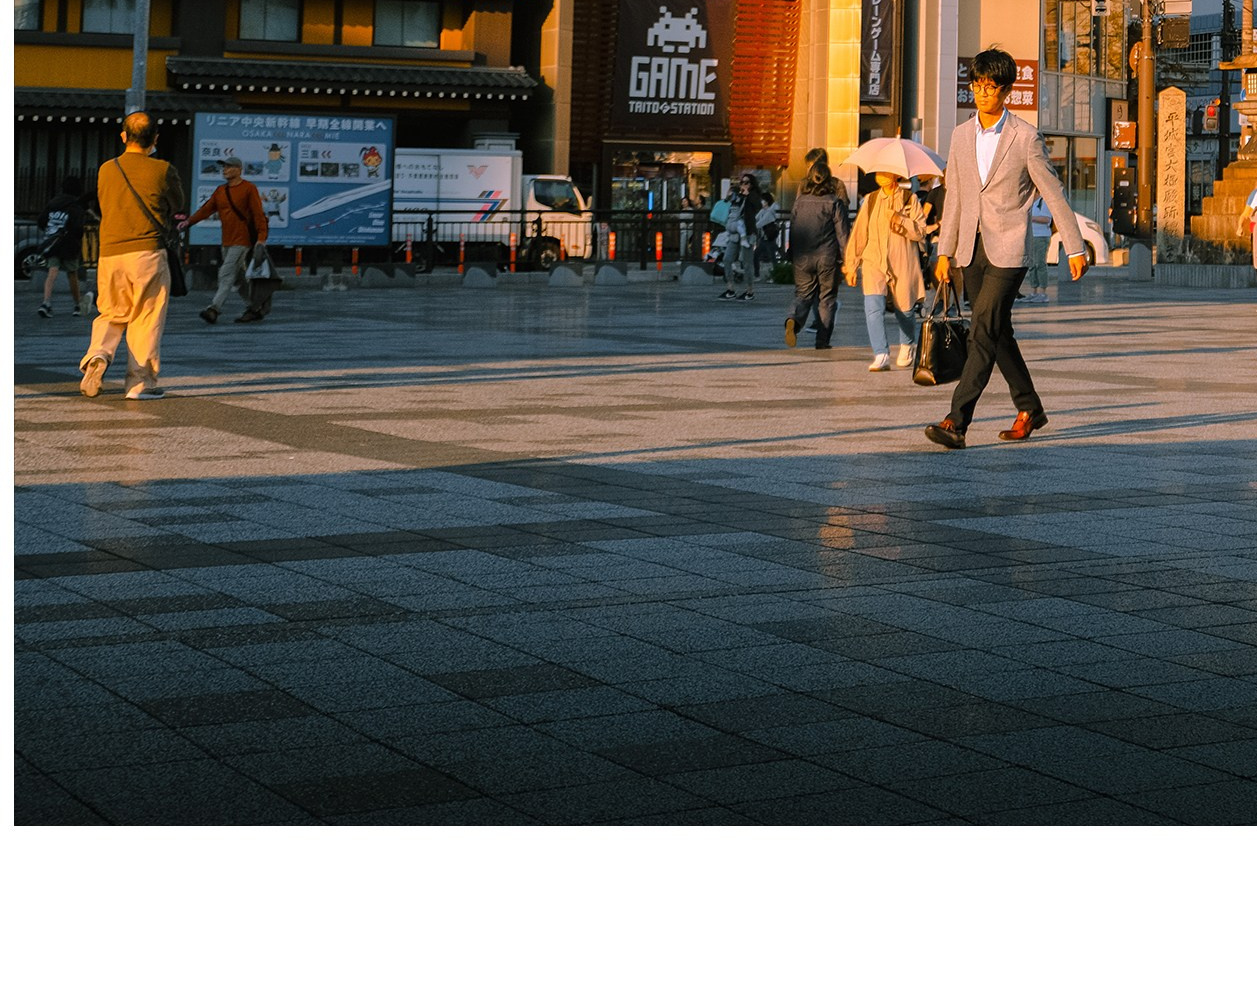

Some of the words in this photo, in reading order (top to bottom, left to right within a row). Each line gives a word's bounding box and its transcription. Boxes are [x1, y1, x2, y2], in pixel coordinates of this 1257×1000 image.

[629, 56, 718, 100] GAME
[629, 101, 660, 114] TAITO
[670, 103, 714, 115] STATION
[241, 129, 273, 138] OSAKA
[286, 131, 311, 139] NARA
[324, 132, 340, 140] MIE
